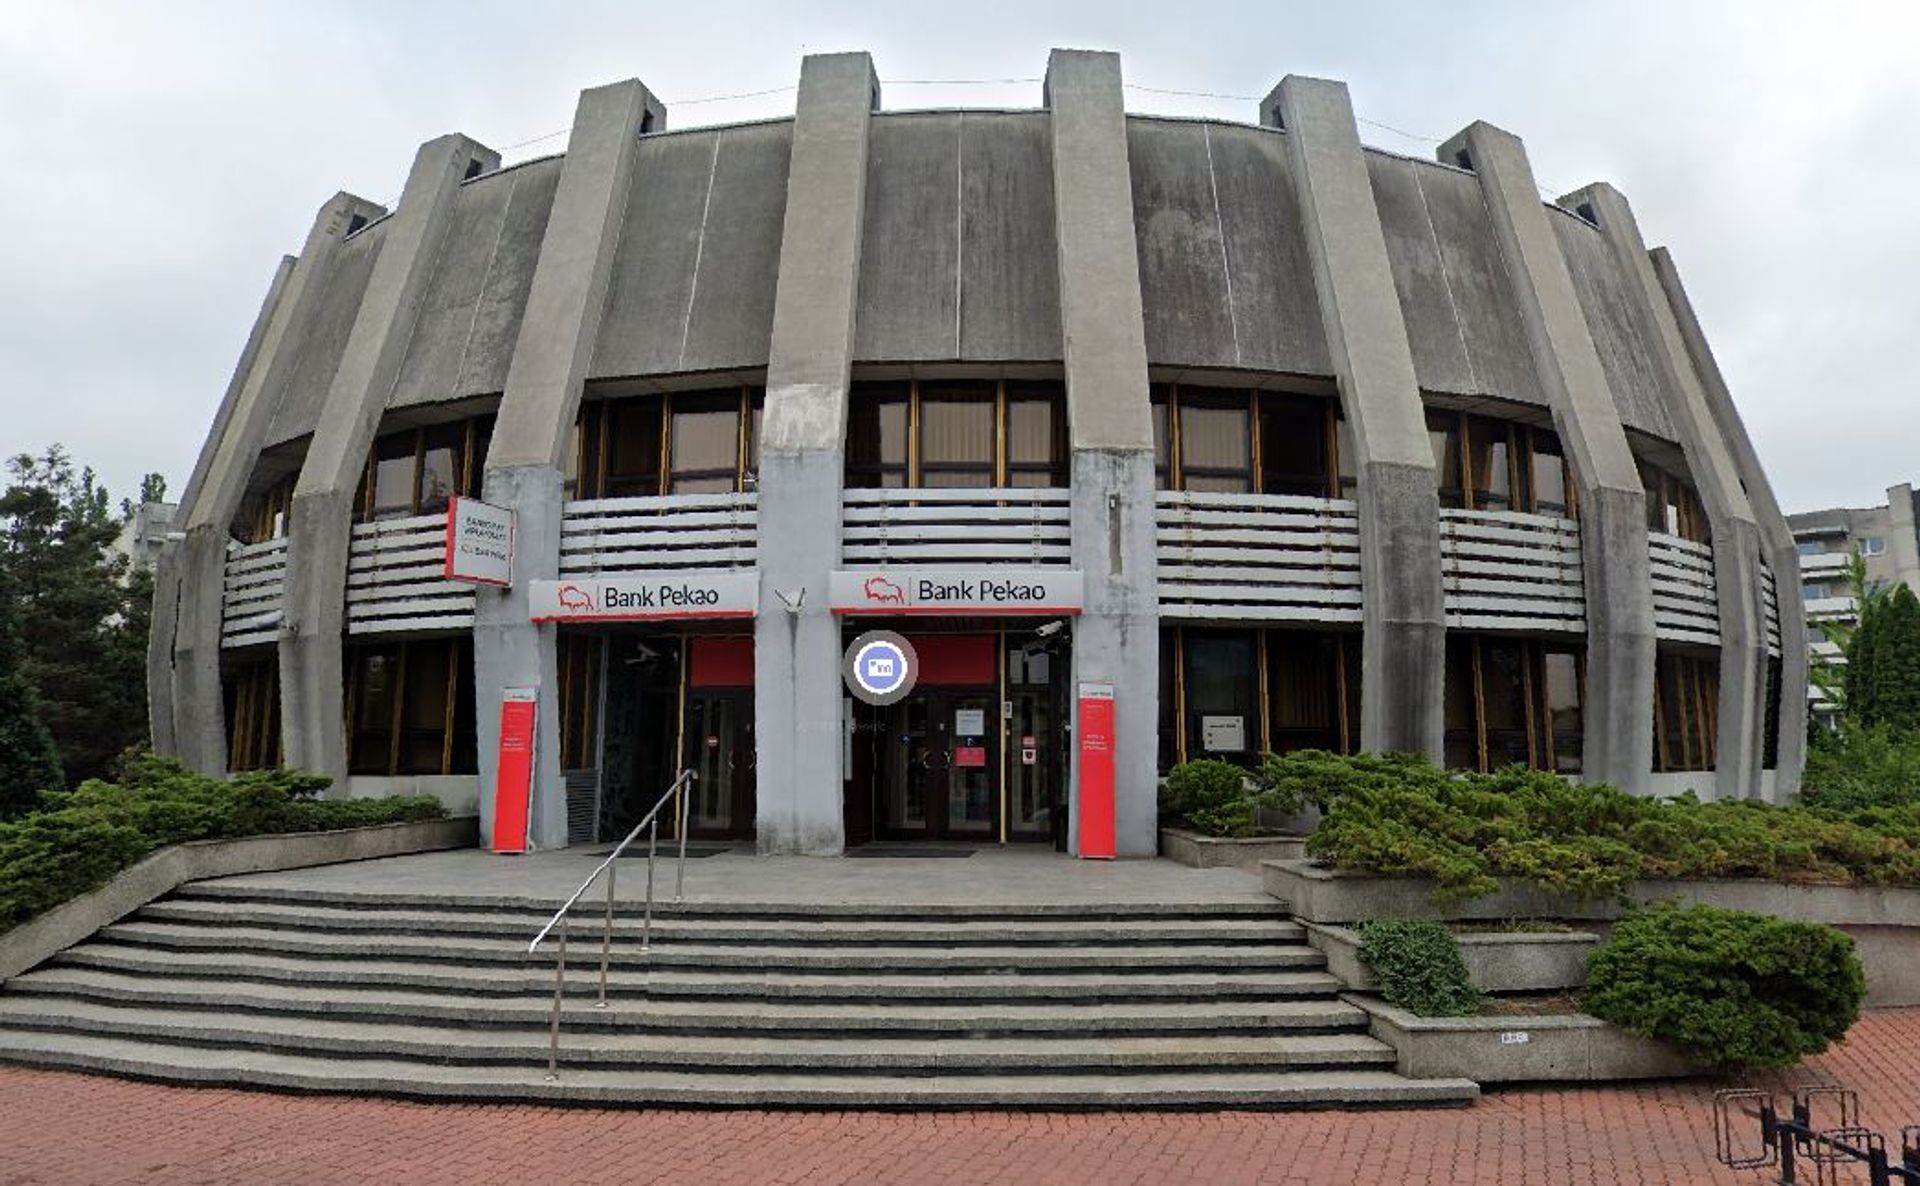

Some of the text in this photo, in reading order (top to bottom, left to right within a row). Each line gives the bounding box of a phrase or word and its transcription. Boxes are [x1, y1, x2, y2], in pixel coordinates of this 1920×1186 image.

[605, 584, 719, 607] Bank Pekao
[919, 579, 1046, 601] Bank Pekao
